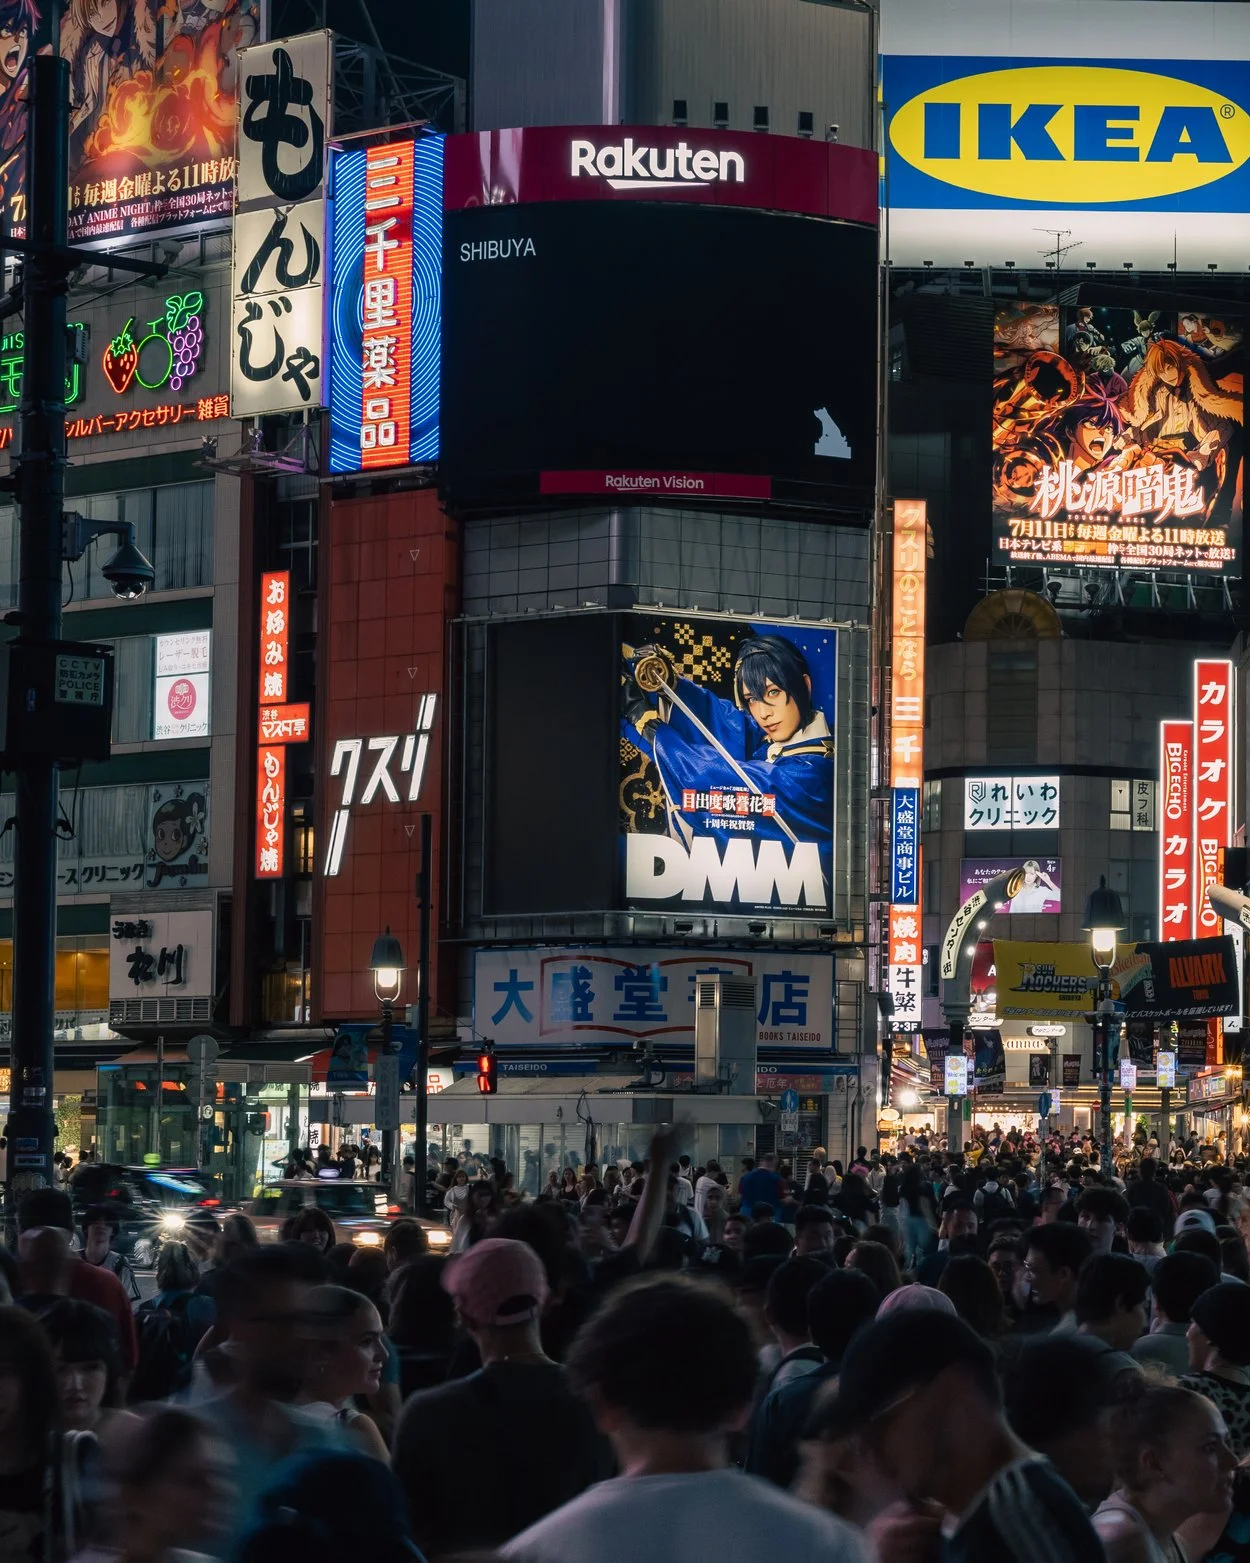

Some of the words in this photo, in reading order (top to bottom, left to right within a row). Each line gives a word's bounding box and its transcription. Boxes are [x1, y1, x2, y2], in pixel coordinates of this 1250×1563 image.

[924, 102, 1235, 163] IKEA
[571, 138, 745, 184] Rakuten
[237, 47, 324, 401] もんじゃ
[460, 237, 537, 263] SHIBUYA
[360, 155, 402, 450] 三千里薬品
[605, 474, 661, 490] Rakuten
[663, 474, 704, 489] Vision
[1030, 463, 1205, 523] 桃源暗鬼
[897, 507, 921, 682] クスリのことなら
[263, 579, 285, 698] お好み焼
[59, 680, 99, 691] POLICE
[262, 709, 279, 721] 渋谷
[1167, 743, 1182, 772] BIG
[1198, 681, 1226, 821] カラオケ
[324, 693, 437, 876] クスリ
[991, 783, 1057, 802] れいわ
[1137, 782, 1149, 825] 皮フ科
[1167, 775, 1182, 819] ECHO
[259, 752, 281, 872] もんじゃ焼
[969, 807, 1057, 826] クリニック
[626, 832, 827, 906] DMM
[897, 796, 913, 896] 大盛堂商事ビル
[1201, 839, 1218, 872] BIG
[1164, 835, 1188, 941] カラオ
[943, 895, 980, 976] 渋谷センター街
[895, 966, 916, 1012] 牛繁
[1169, 953, 1227, 988] ALVARK
[491, 965, 810, 1027] 大盛堂店
[759, 1031, 784, 1042] BOOKS
[787, 1032, 821, 1043] TAISEIDO
[503, 1064, 547, 1072] TAISEIDO
